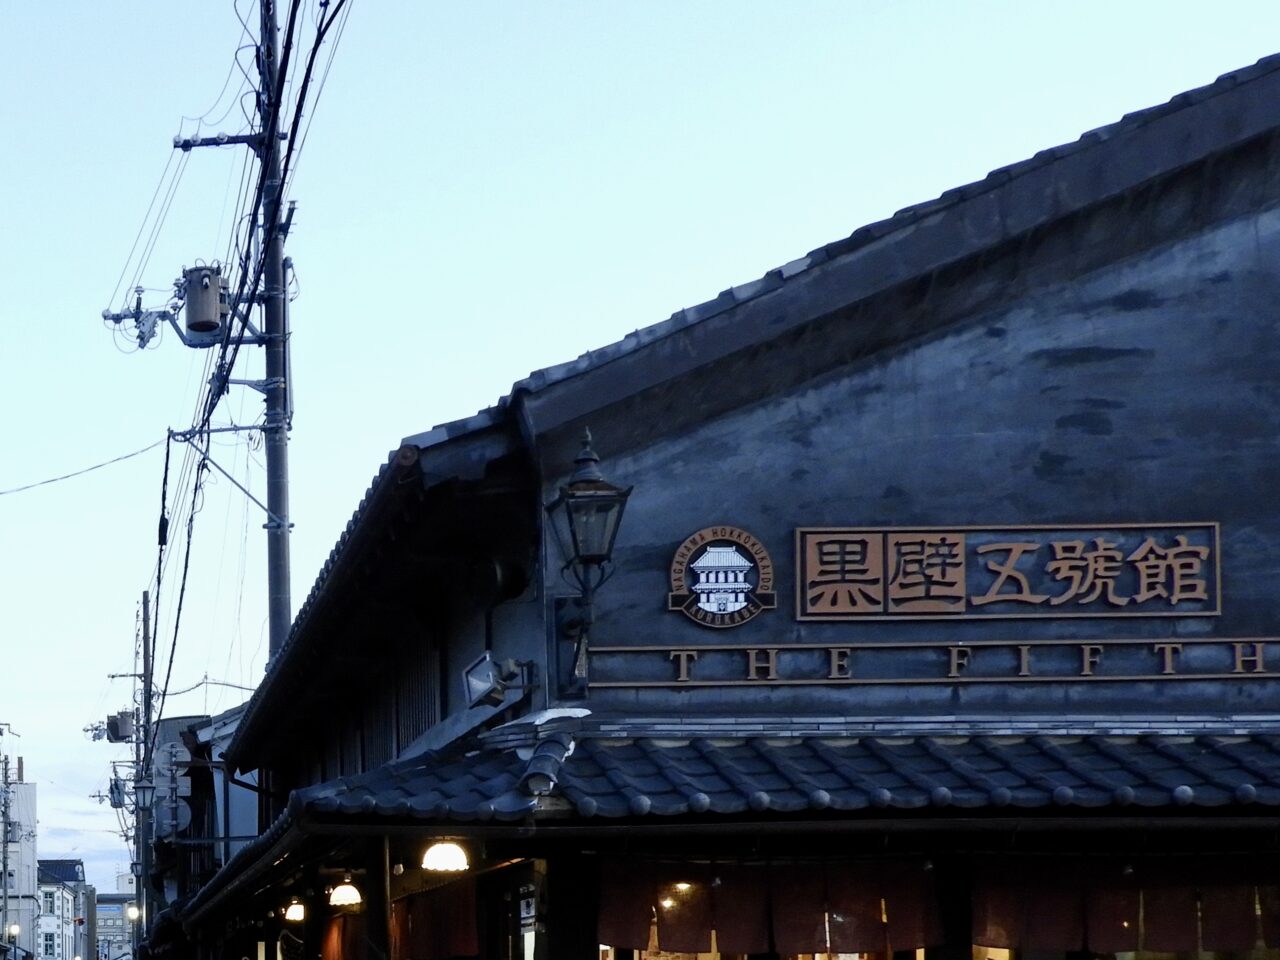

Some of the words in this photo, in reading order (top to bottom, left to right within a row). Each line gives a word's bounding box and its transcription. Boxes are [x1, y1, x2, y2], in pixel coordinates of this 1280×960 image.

[673, 533, 707, 591] NAGAHAMA
[711, 527, 772, 591] HOKKOKUKAIDO
[689, 603, 759, 625] KUROKABE
[669, 647, 854, 682] THE
[946, 642, 1267, 679] FIFTH
